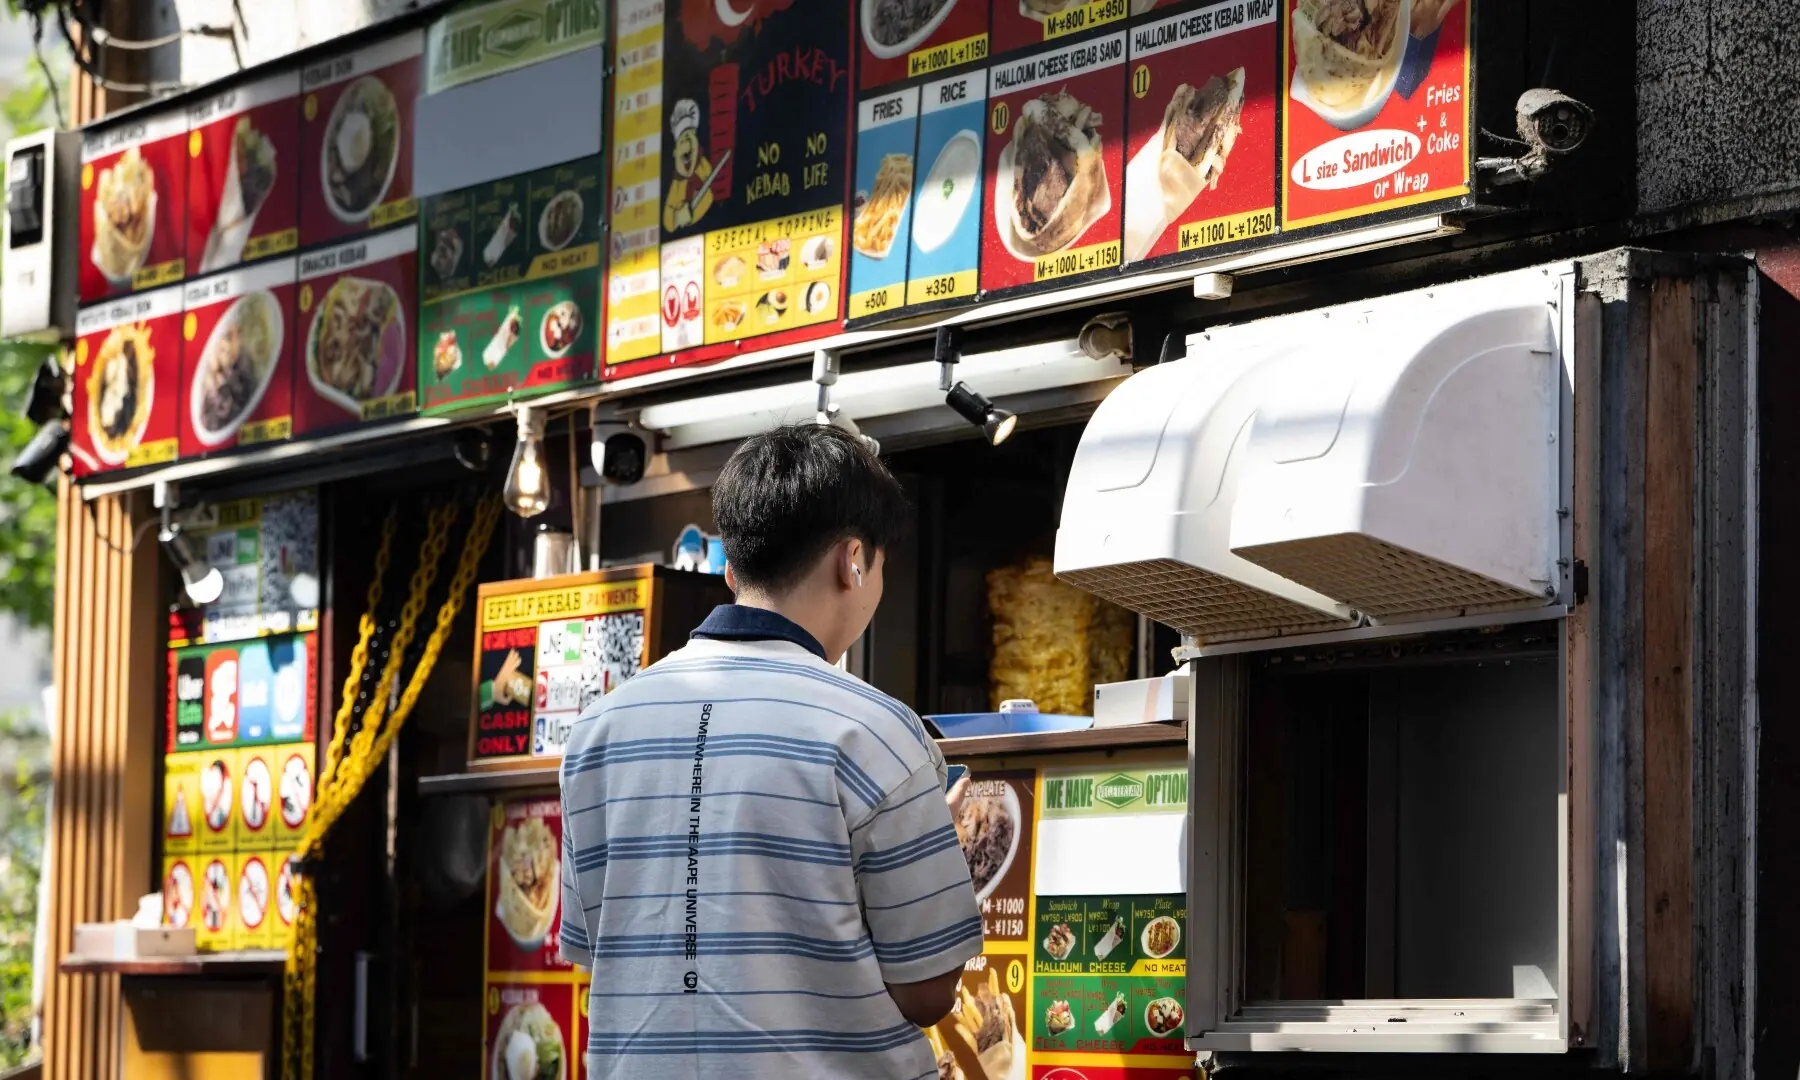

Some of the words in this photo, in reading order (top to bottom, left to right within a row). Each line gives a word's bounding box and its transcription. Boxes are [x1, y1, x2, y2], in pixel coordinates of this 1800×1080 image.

[1047, 9, 1084, 35] M-¥800
[1089, 0, 1124, 24] L-¥950
[1135, 24, 1177, 53] HALLOUMI
[1179, 12, 1213, 40] CHEESE
[1214, 4, 1244, 31] KEBAB
[1246, 0, 1274, 22] WRAP
[912, 49, 948, 73] M-¥1000
[950, 38, 986, 63] L-¥1150
[1038, 53, 1069, 79] CHEESE
[1070, 45, 1097, 71] KEBAB
[1099, 38, 1122, 62] SAND
[741, 47, 848, 113] TURKEY
[940, 80, 967, 104] RICE
[1135, 68, 1147, 94] 11
[1426, 83, 1461, 107] Fries
[872, 97, 903, 122] FRIES
[994, 105, 1008, 130] 10
[1439, 112, 1447, 127] &
[756, 142, 780, 168] NO
[805, 132, 827, 158] NO
[1427, 130, 1460, 155] Coke
[1302, 158, 1311, 183] L
[1316, 160, 1338, 180] size
[1343, 136, 1413, 174] Sandwich
[745, 172, 790, 205] KEBAB
[803, 162, 828, 190] LIFE
[1374, 179, 1389, 199] or
[1394, 170, 1429, 194] Wrap
[1181, 224, 1225, 249] M-¥1100
[1227, 213, 1272, 240] L-¥1250
[1037, 254, 1077, 279] M-¥1000
[1079, 245, 1118, 270] L-¥1150
[925, 276, 955, 296] ¥350
[865, 290, 888, 309] ¥500
[536, 592, 581, 615] KEBAB
[479, 711, 529, 730] CASH
[478, 735, 529, 753] ONLY
[691, 703, 713, 794] SOMEWHERE
[690, 798, 701, 813] IN
[1046, 778, 1063, 809] WE
[1065, 778, 1094, 808] HAVE
[688, 816, 700, 843] THE
[686, 847, 699, 885] AAPE
[982, 898, 1025, 915] M-¥1000
[1048, 900, 1078, 912] Sandwich
[1102, 898, 1120, 911] Wrap
[1154, 897, 1173, 909] Plate
[685, 889, 698, 961] UNIVERSE
[984, 919, 1024, 936] L-¥1150
[1012, 965, 1019, 988] 9
[1036, 960, 1083, 973] HALLOUMI
[1089, 962, 1126, 973] CHEESE
[1144, 963, 1158, 973] NO
